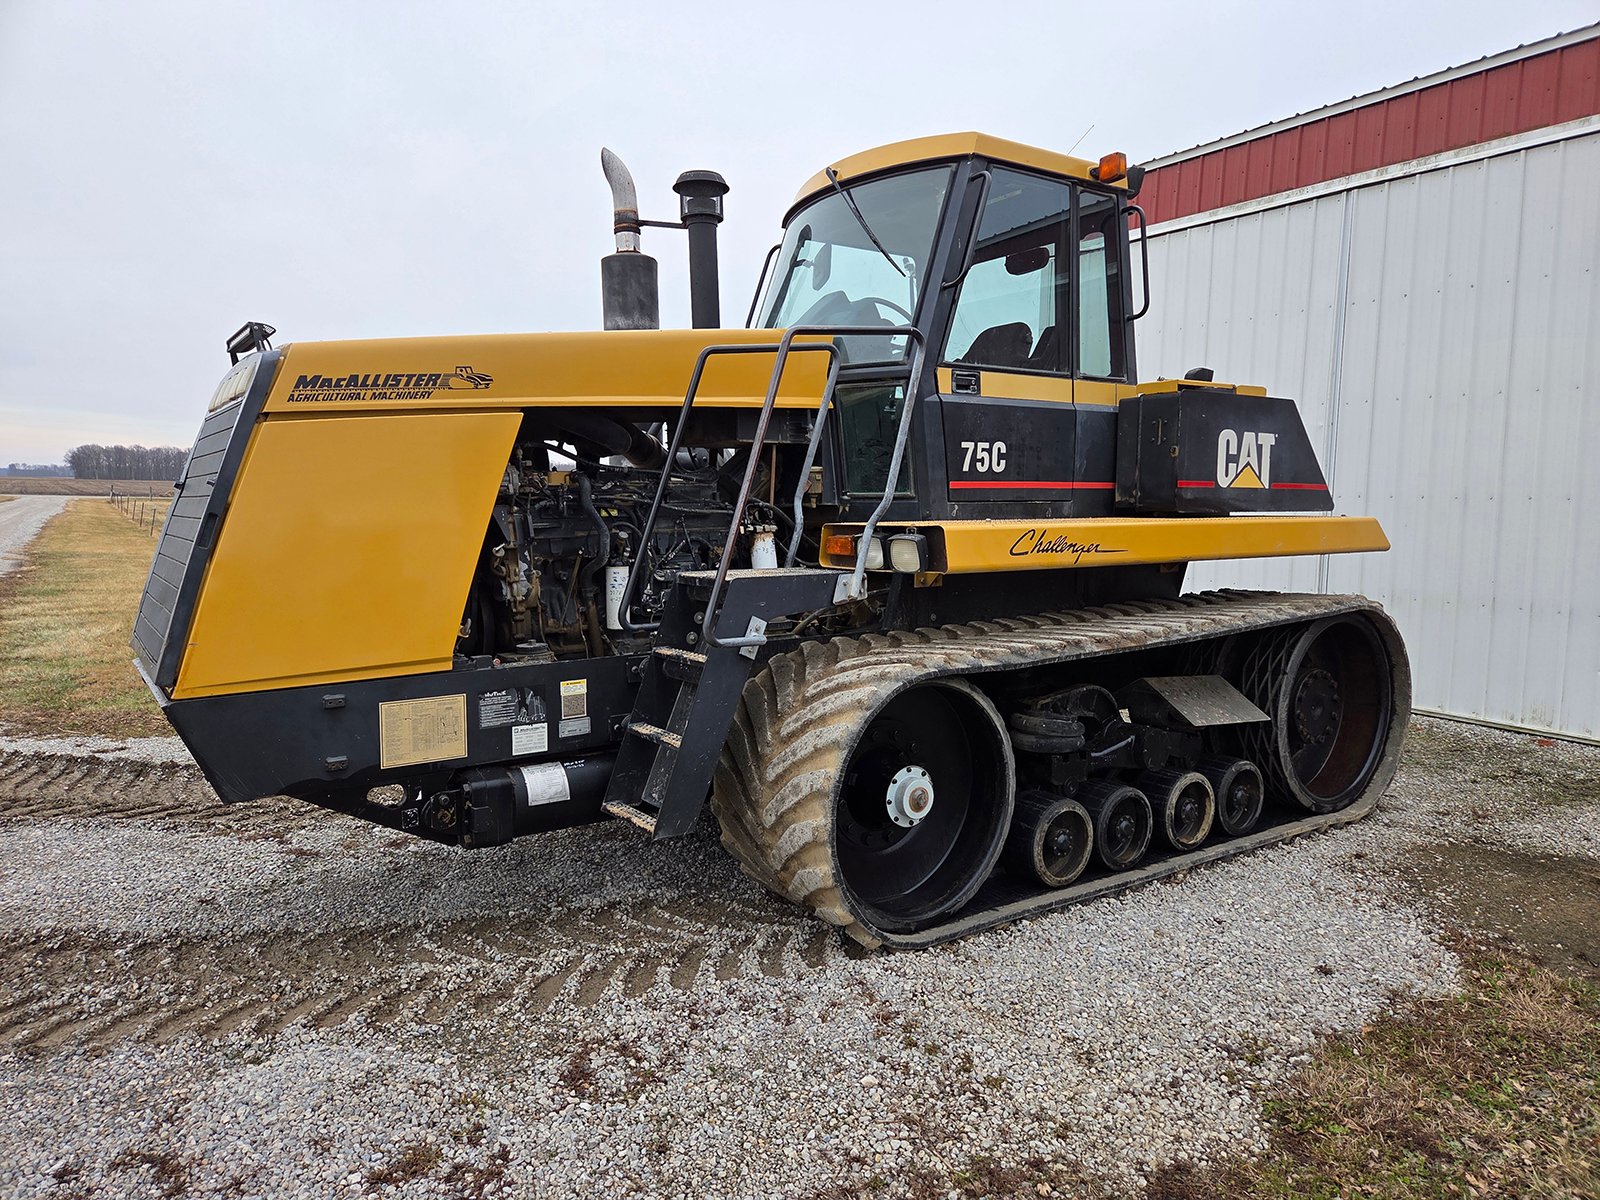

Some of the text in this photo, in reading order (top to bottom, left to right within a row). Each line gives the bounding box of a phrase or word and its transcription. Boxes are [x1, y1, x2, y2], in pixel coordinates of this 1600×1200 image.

[286, 390, 434, 403] AGRICULTURAL MACHINERY
[960, 440, 1007, 473] 75C
[1216, 427, 1276, 489] CAT
[1008, 527, 1129, 564] Challenger
